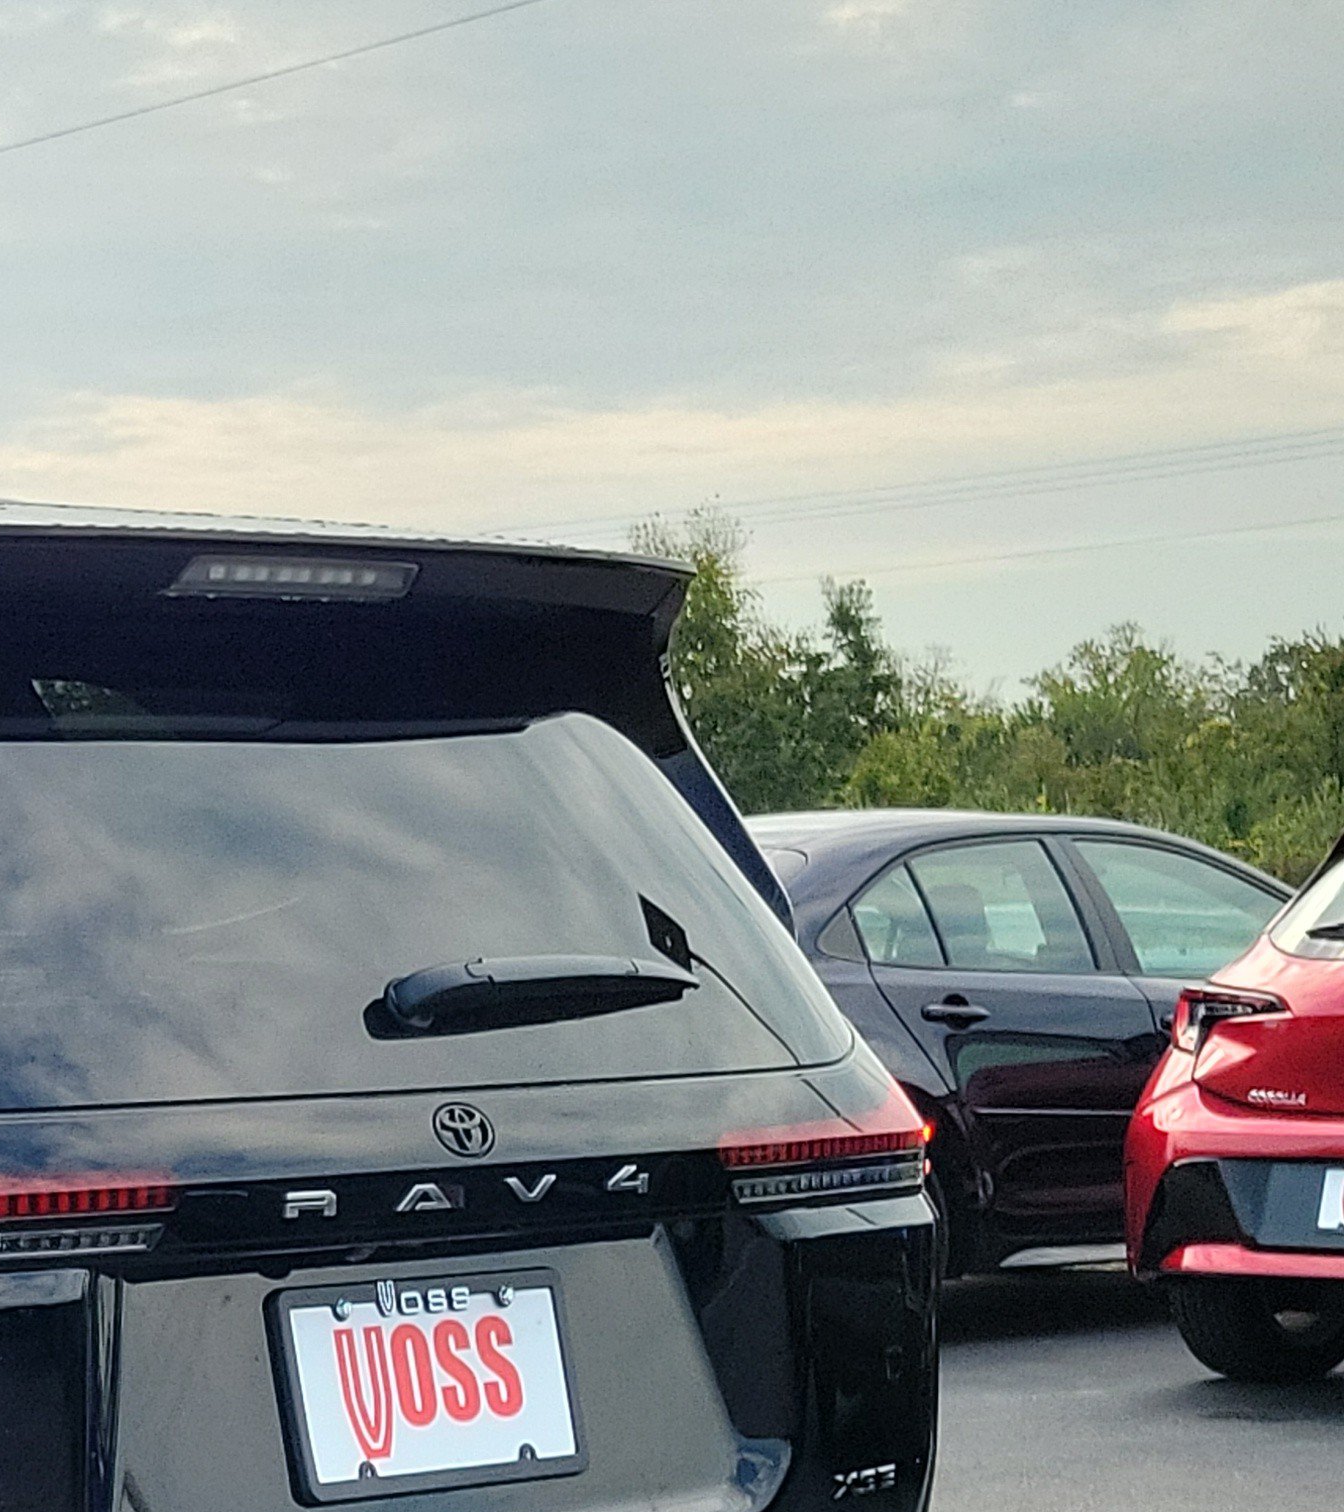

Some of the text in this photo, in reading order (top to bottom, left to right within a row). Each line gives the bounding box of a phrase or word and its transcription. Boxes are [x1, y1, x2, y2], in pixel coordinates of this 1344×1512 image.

[283, 1164, 650, 1219] RAV4
[376, 1280, 470, 1316] VOSS
[333, 1315, 525, 1460] VOSS
